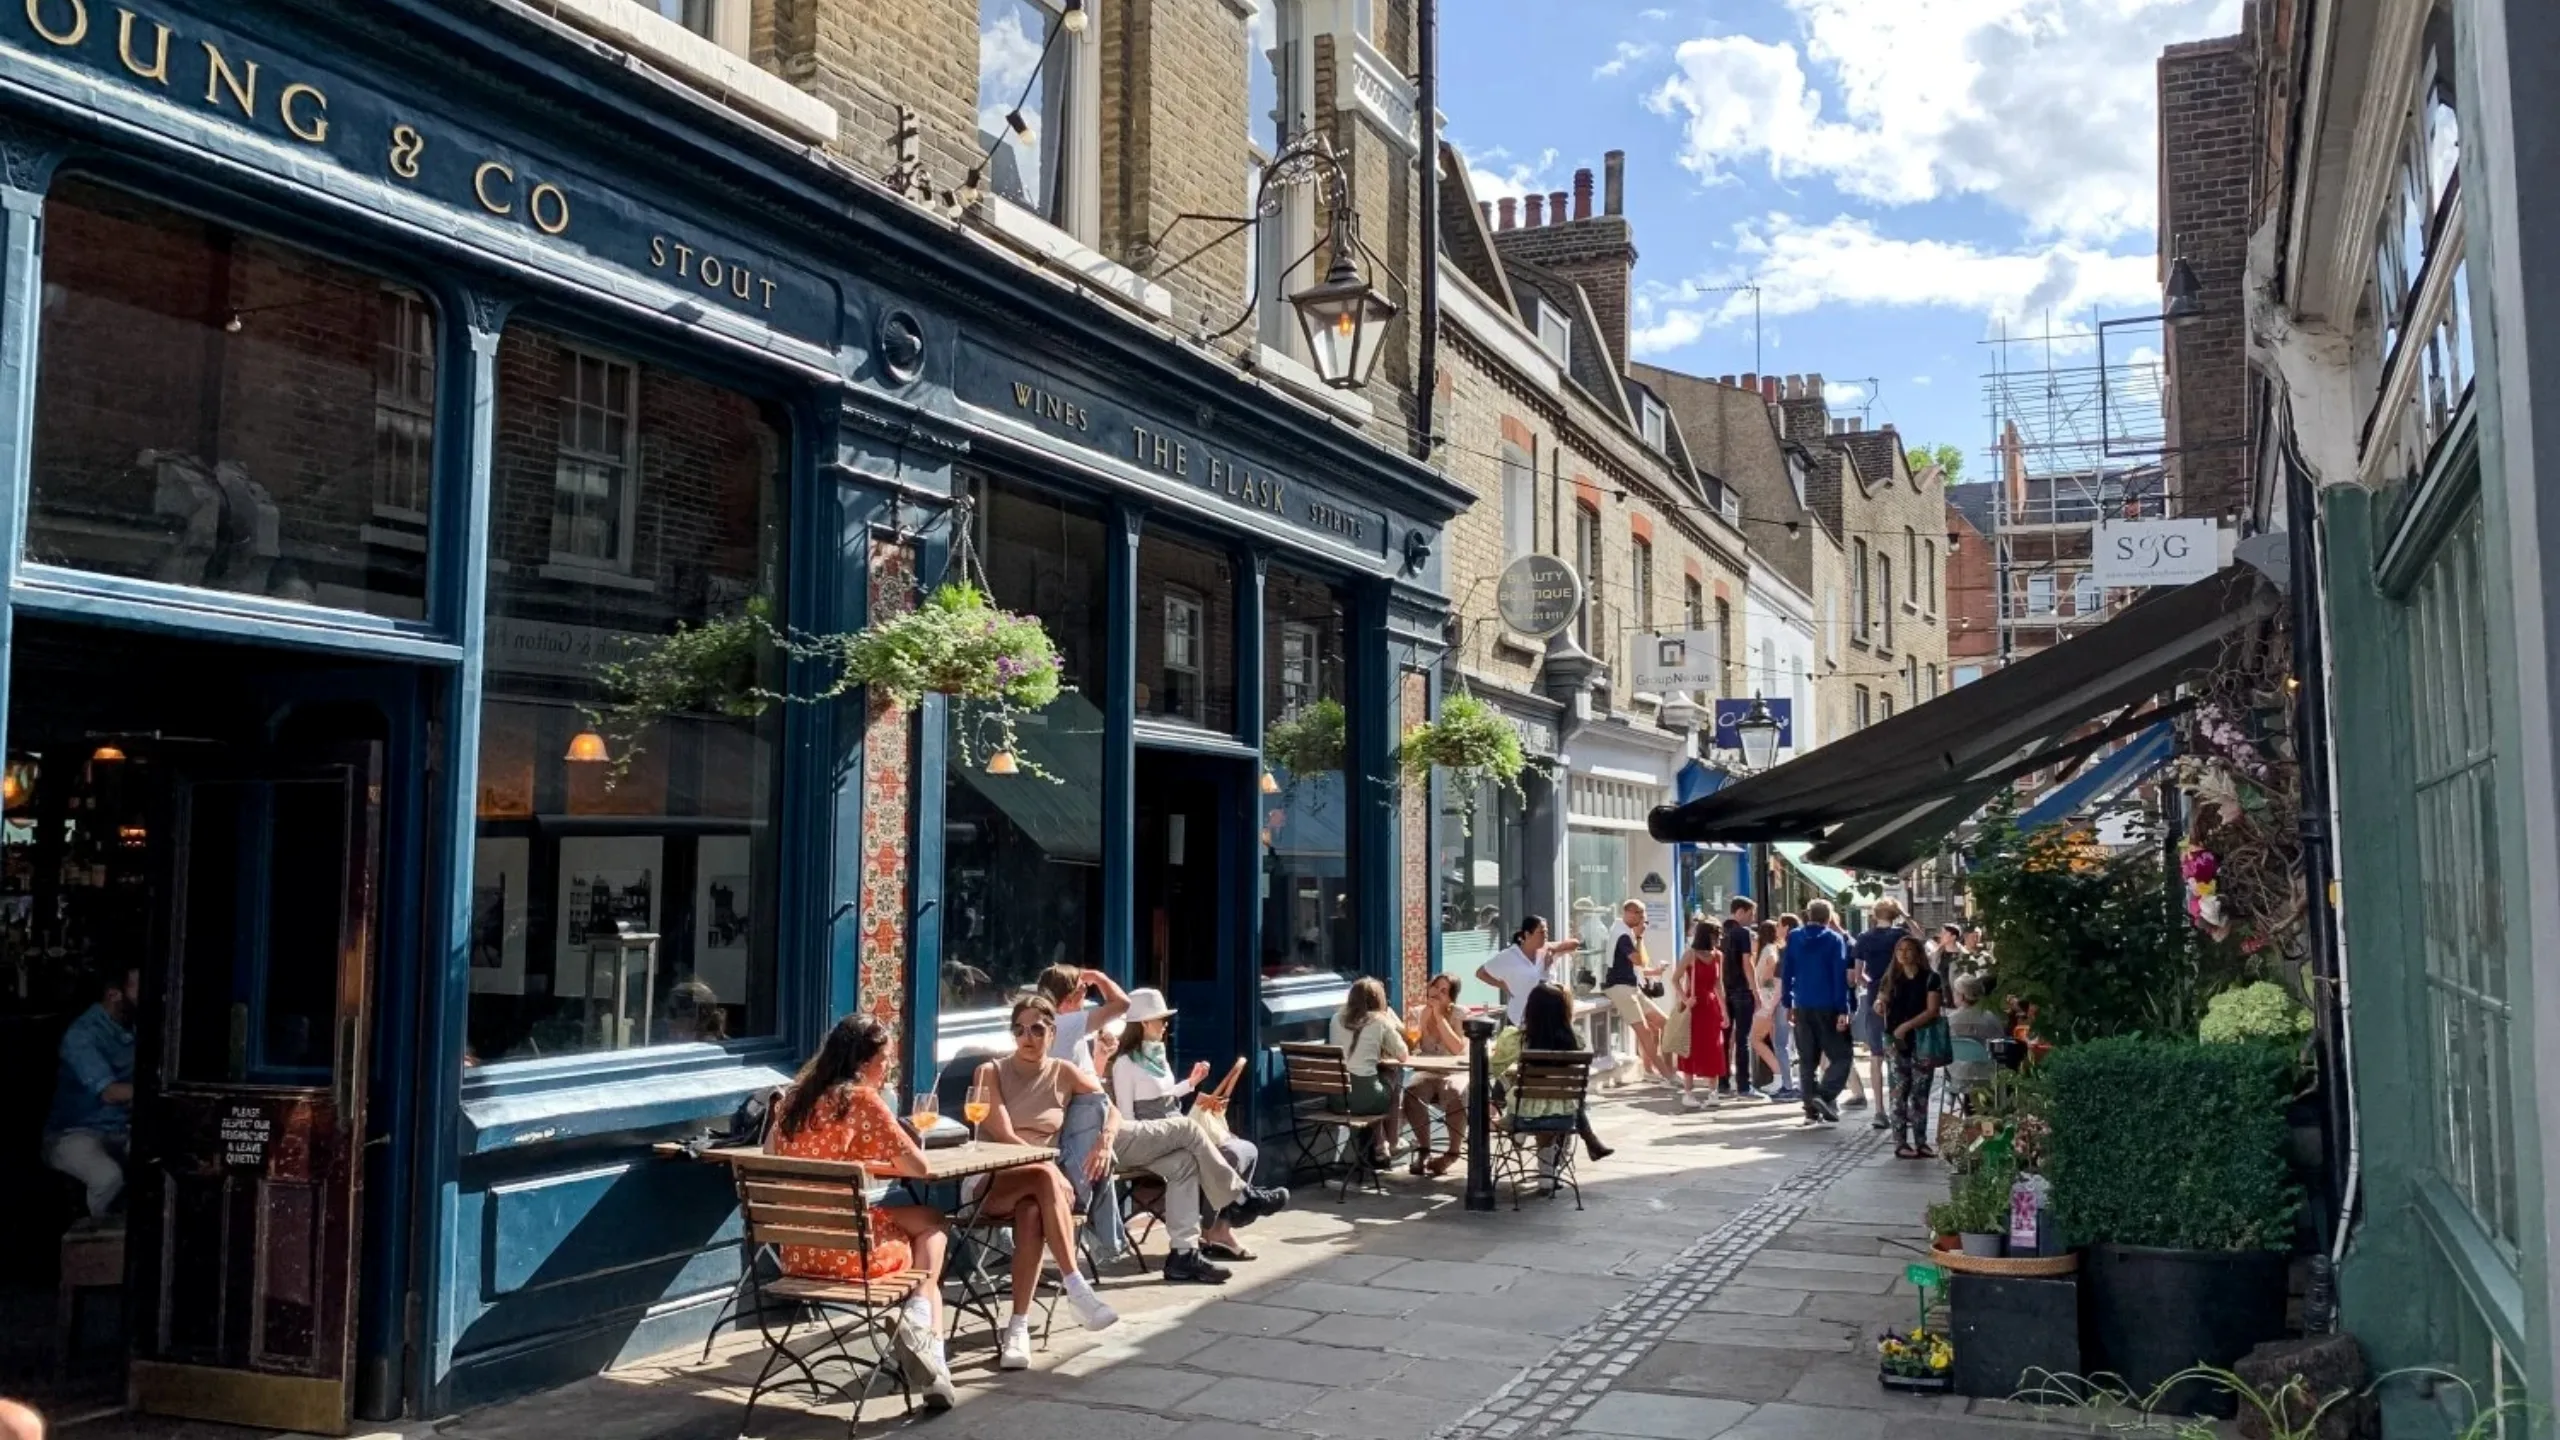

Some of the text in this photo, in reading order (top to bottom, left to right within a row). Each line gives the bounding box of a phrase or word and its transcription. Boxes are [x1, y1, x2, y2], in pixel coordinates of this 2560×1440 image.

[389, 123, 424, 178] &
[474, 160, 570, 235] CO
[651, 235, 778, 310] STOUT
[1013, 381, 1364, 540] WINES THE FLASK SPIRITS
[1506, 570, 1564, 584] BEAUTY
[1499, 587, 1573, 601] BOUTIQUE
[1635, 672, 1711, 687] GroupNexus
[232, 1106, 260, 1117] PLEASE
[222, 1118, 270, 1129] RESPECT OUR
[236, 1142, 261, 1153] LEAVE
[226, 1153, 261, 1165] QUIETLY
